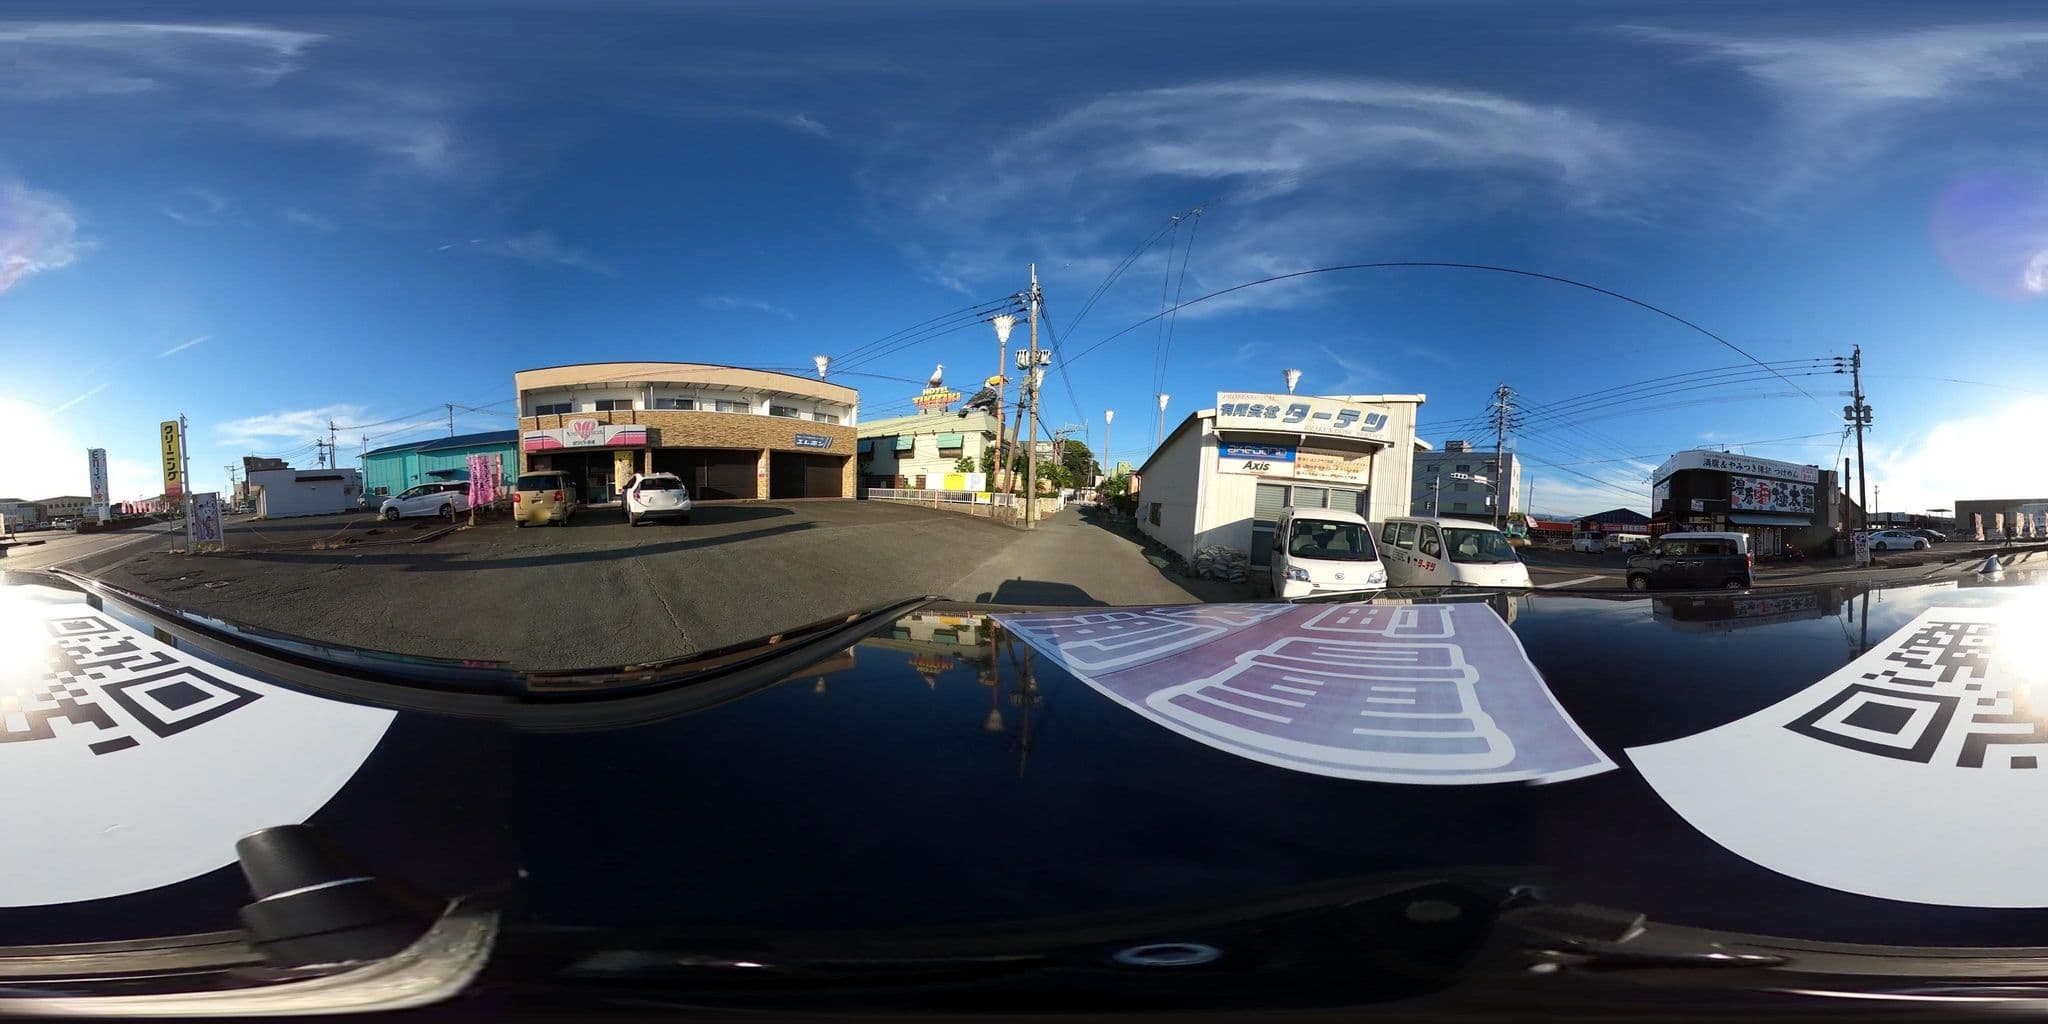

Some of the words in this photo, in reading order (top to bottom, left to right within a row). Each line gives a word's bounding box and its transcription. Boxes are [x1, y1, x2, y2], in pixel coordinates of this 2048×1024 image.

[922, 387, 949, 396] HOTEL
[1220, 403, 1280, 419] 有限会社
[1282, 403, 1388, 432] ターテツ
[164, 425, 178, 481] クリーニング
[1243, 460, 1270, 471] Axis
